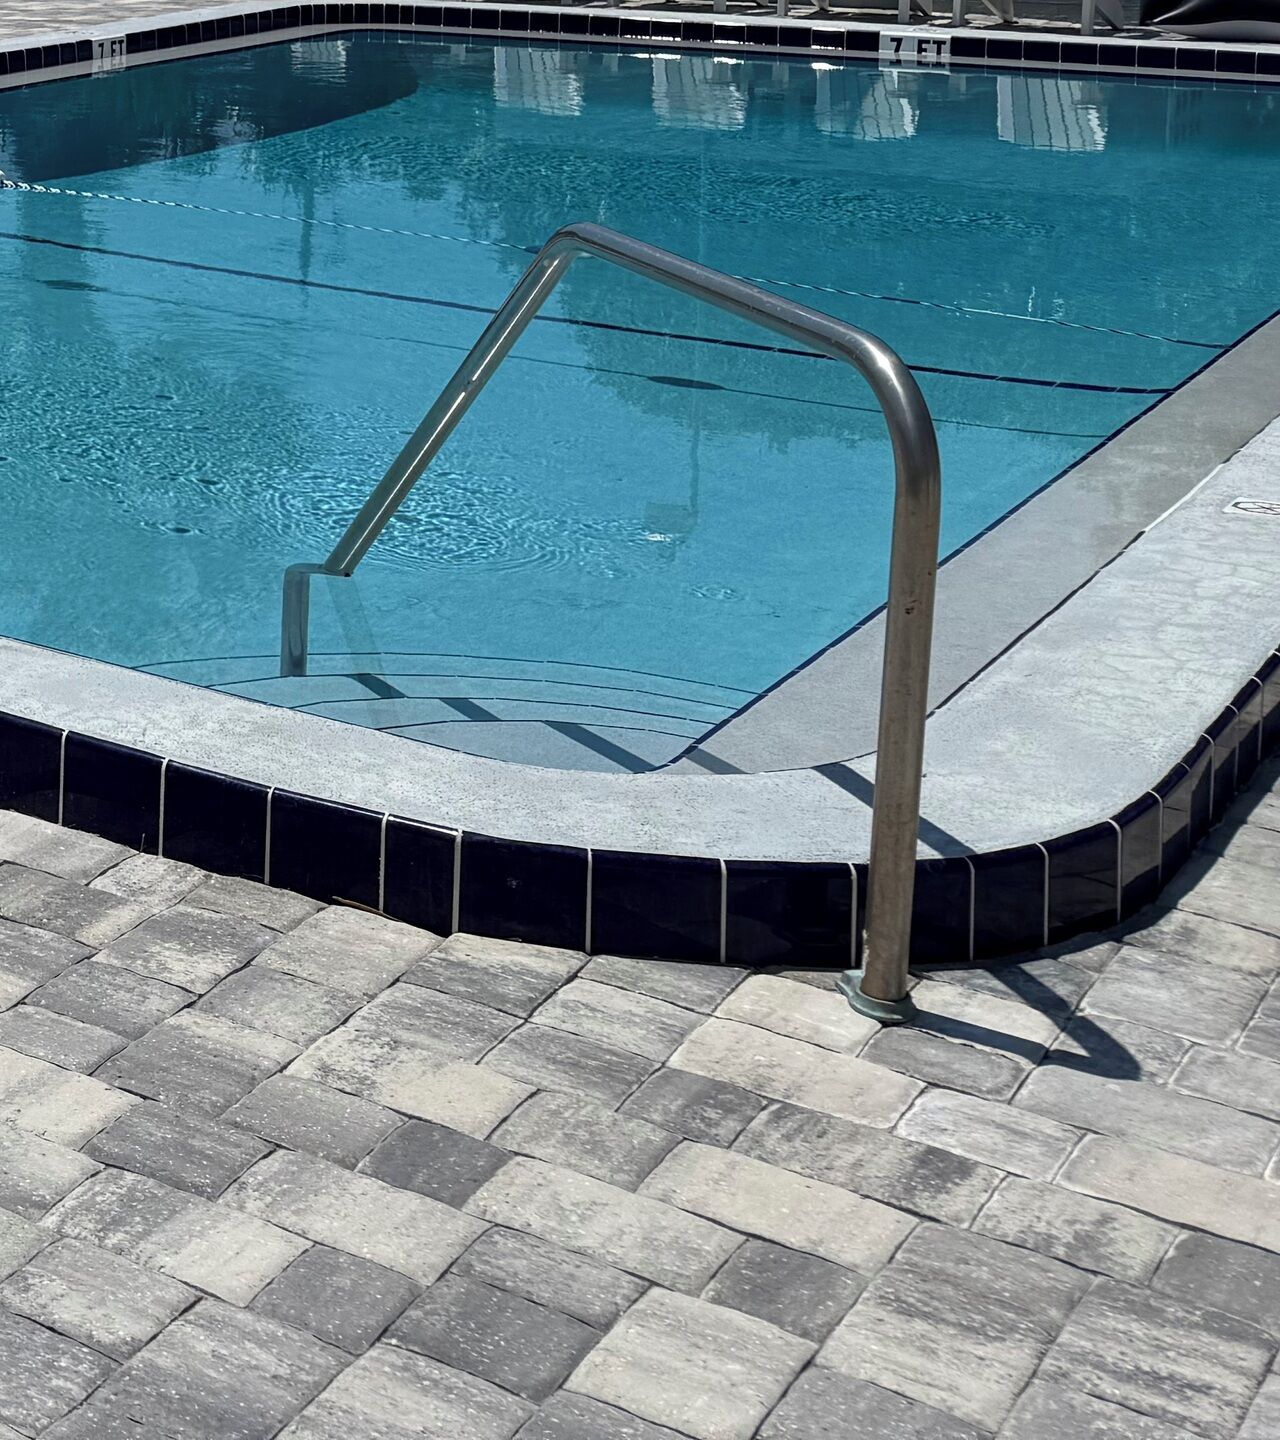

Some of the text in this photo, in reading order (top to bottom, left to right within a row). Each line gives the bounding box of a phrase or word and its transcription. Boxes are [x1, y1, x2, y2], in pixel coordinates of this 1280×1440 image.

[111, 40, 124, 57] FT
[890, 37, 946, 55] 7 FT
